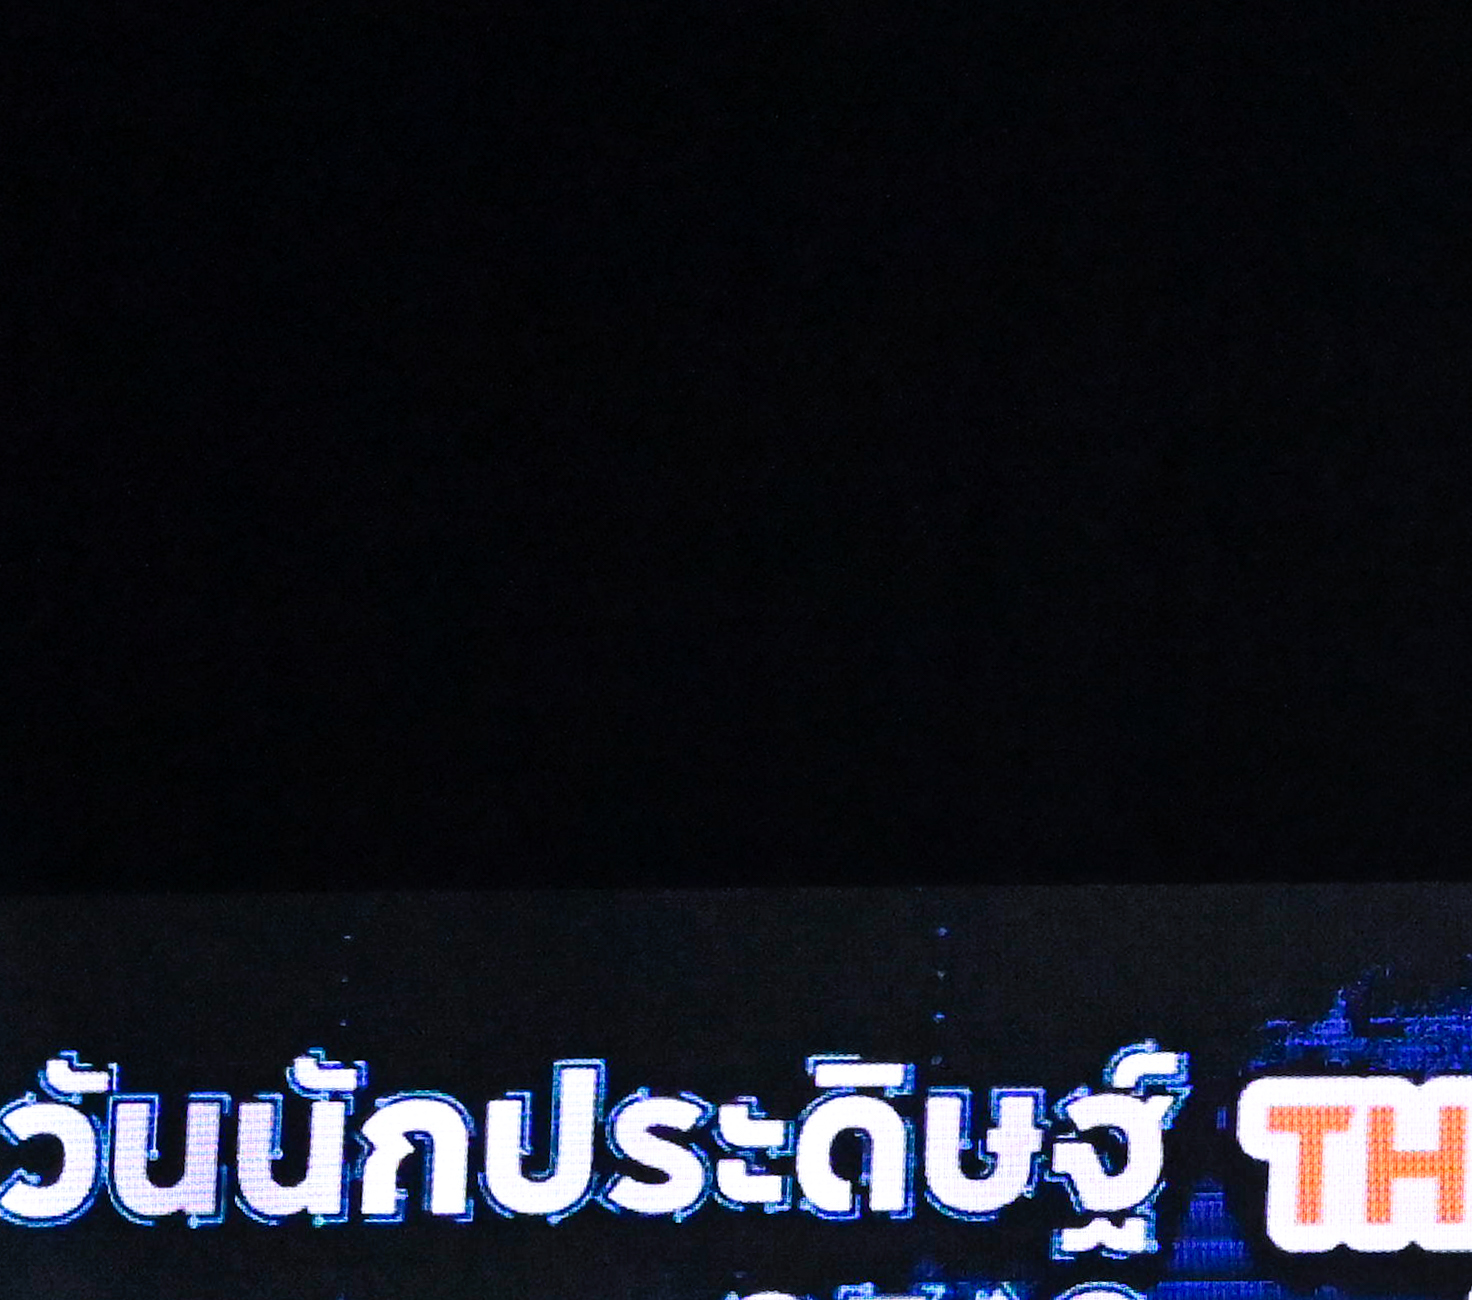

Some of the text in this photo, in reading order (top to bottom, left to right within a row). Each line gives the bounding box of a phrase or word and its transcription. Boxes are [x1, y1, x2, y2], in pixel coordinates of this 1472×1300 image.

[0, 1042, 1192, 1256] วันนักประดิษฐ์
